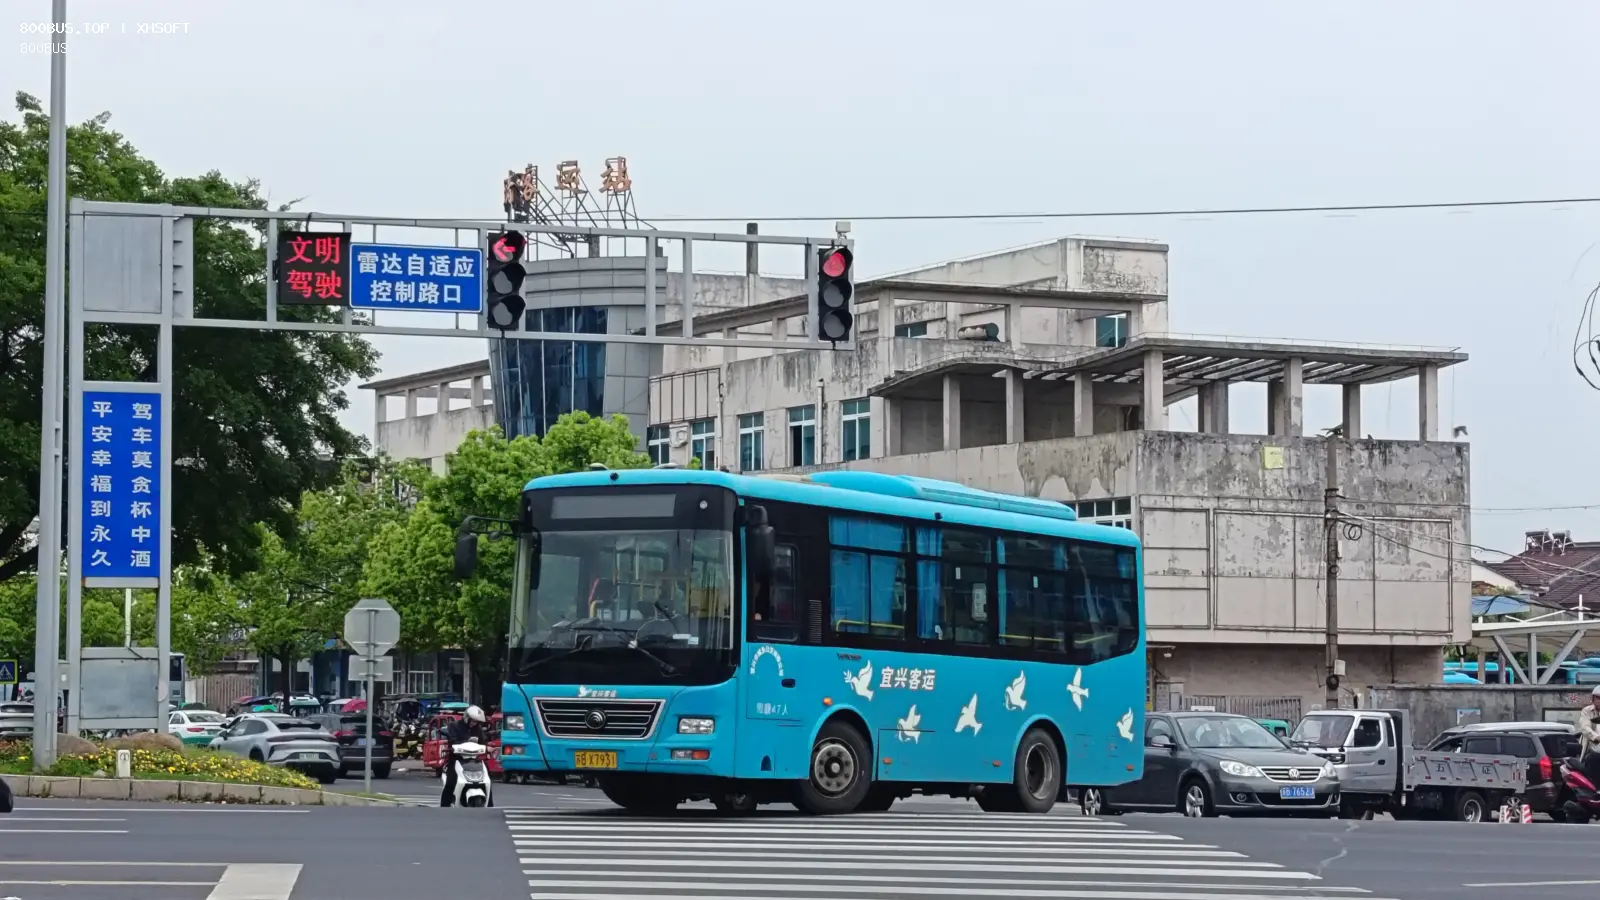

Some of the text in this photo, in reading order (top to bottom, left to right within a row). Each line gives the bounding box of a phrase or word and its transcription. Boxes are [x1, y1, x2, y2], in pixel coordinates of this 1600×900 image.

[285, 236, 341, 265] 文明
[357, 251, 475, 278] 雷达自适应
[286, 269, 343, 299] 驾驶
[370, 280, 461, 304] 控制路口
[90, 401, 112, 567] 平安幸福到永久
[130, 402, 153, 568] 驾车莫贪杯中酒
[879, 666, 936, 691] 宜兴客运
